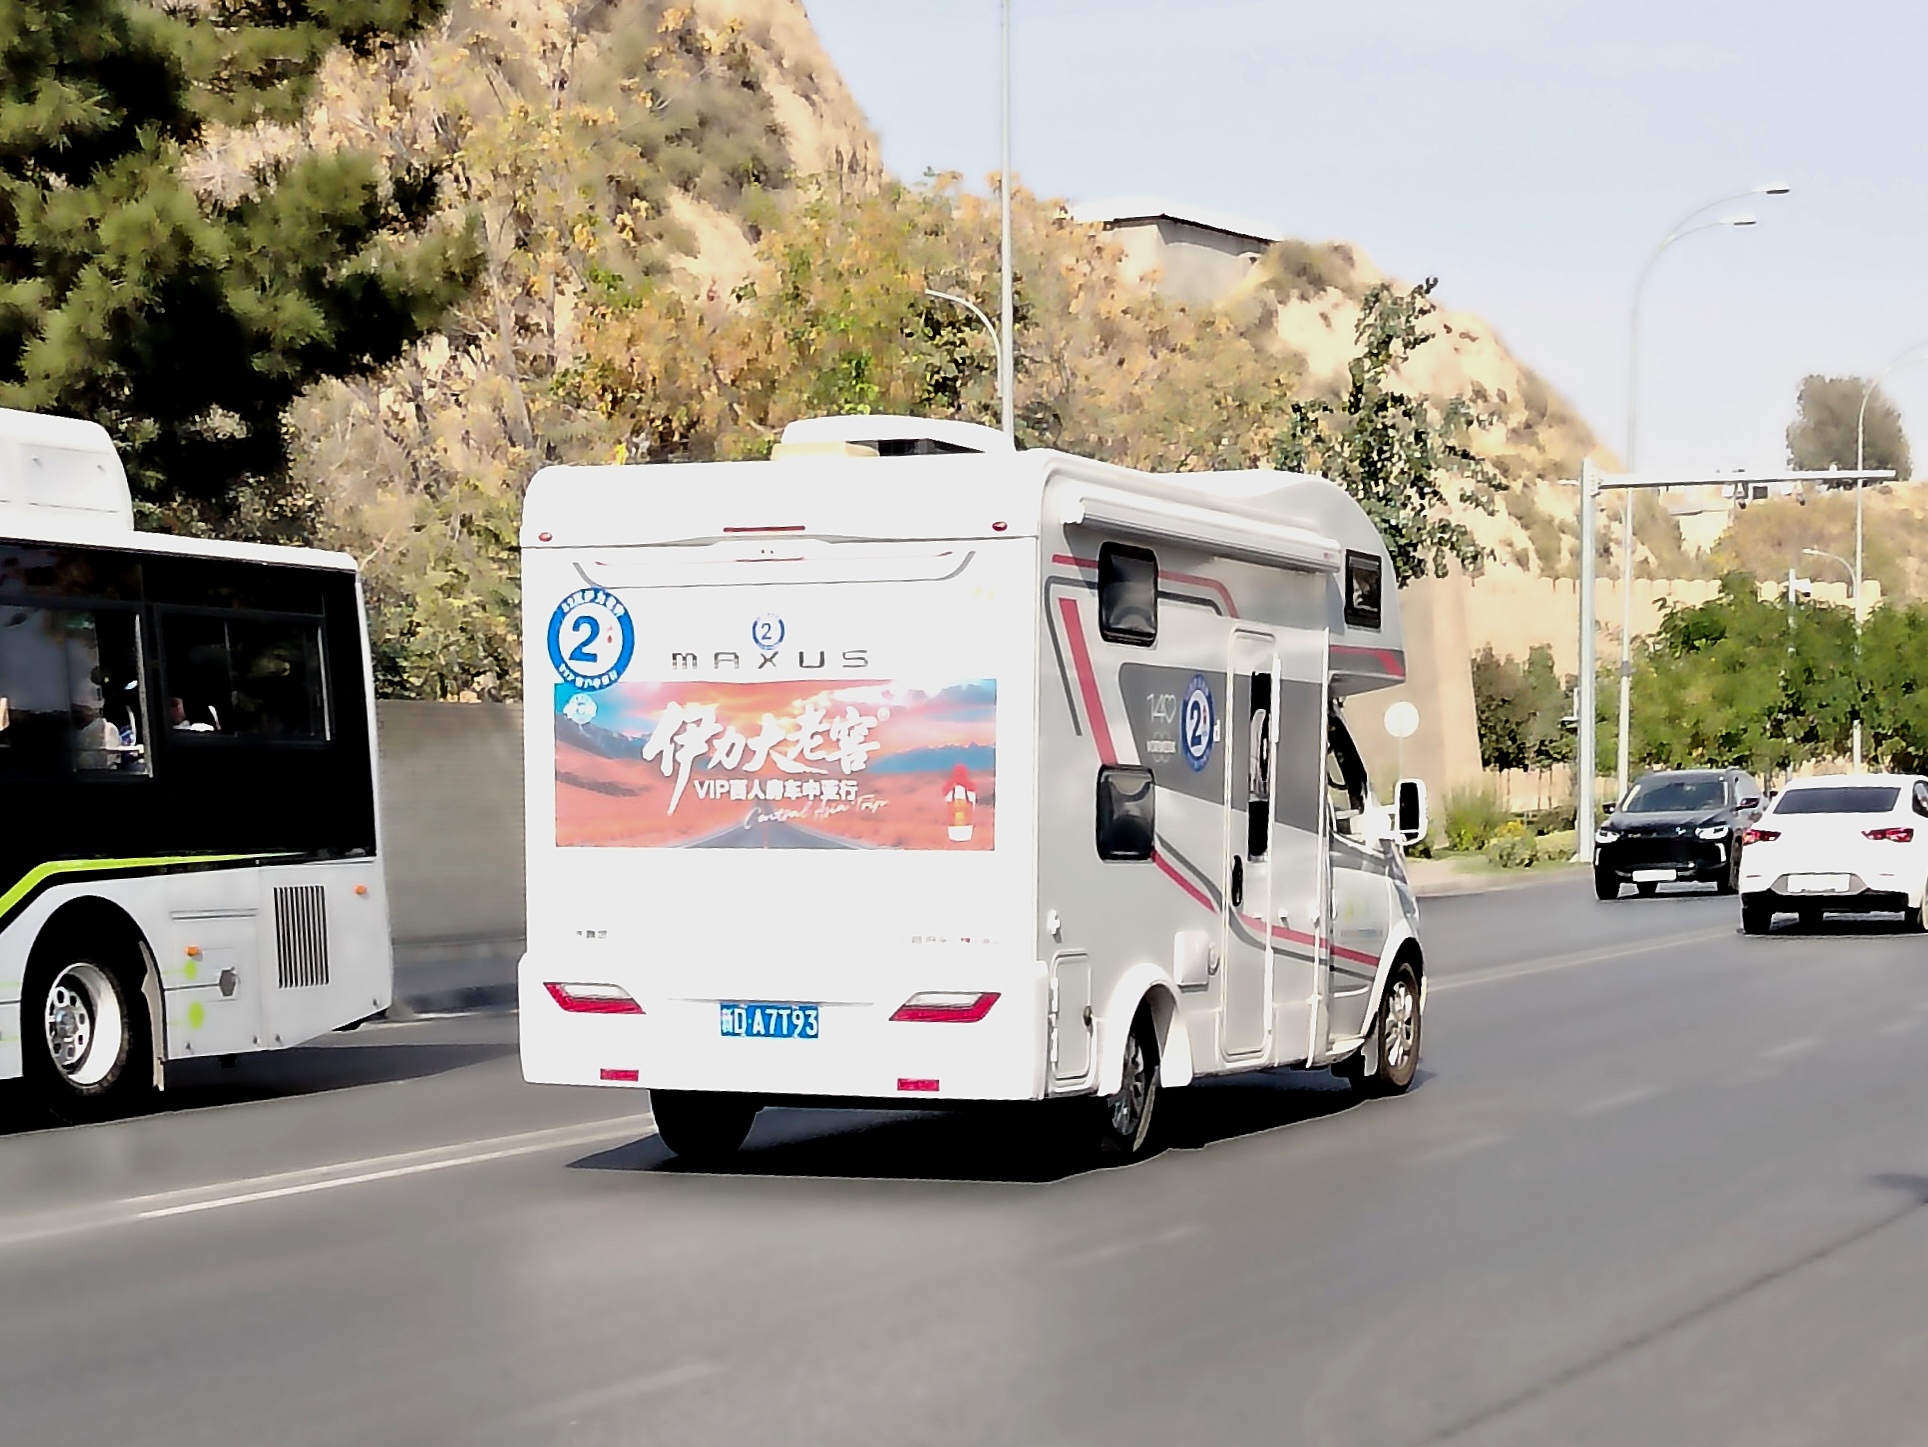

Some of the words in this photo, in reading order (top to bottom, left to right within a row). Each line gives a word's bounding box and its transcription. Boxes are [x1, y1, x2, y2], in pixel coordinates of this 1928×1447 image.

[569, 615, 600, 663] 2
[761, 623, 772, 640] 2
[672, 650, 868, 670] MAXUS
[1190, 700, 1203, 748] 2
